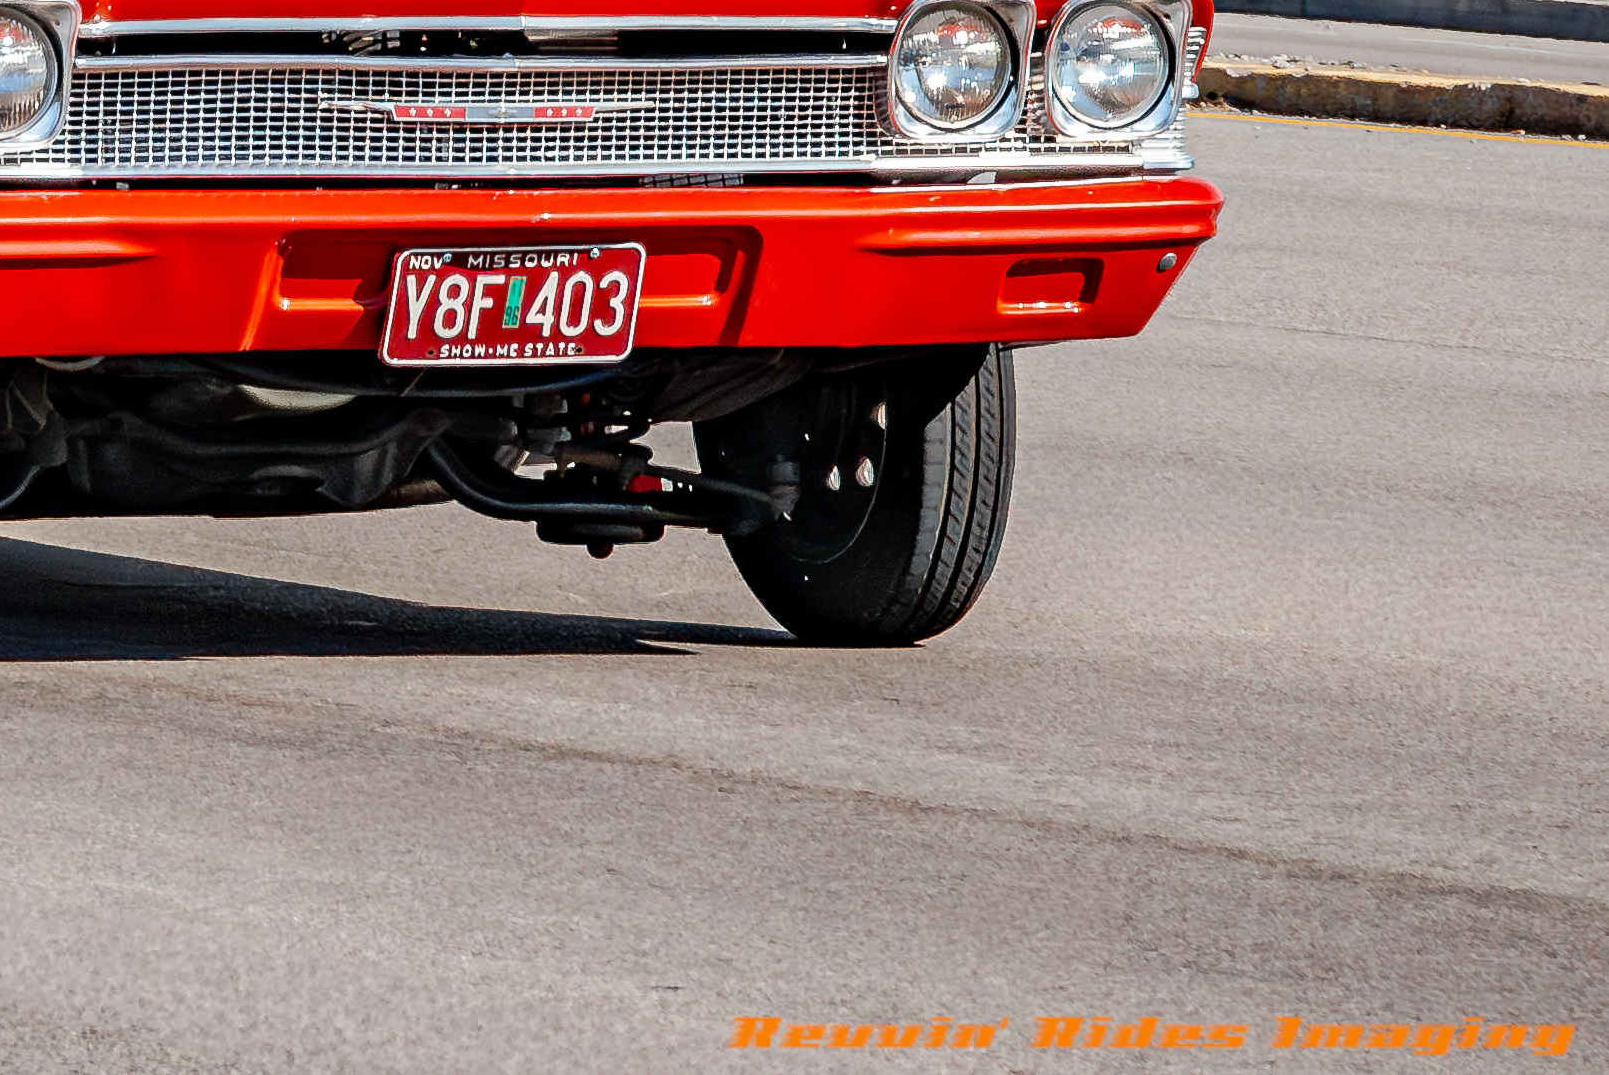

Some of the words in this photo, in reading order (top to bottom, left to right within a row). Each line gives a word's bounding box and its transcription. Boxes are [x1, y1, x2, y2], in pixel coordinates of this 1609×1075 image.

[409, 255, 443, 270] NOV
[467, 253, 579, 269] MISSOURI
[406, 273, 506, 340] Y8F
[526, 270, 629, 337] 403
[504, 305, 520, 326] 96
[523, 342, 577, 357] STATE
